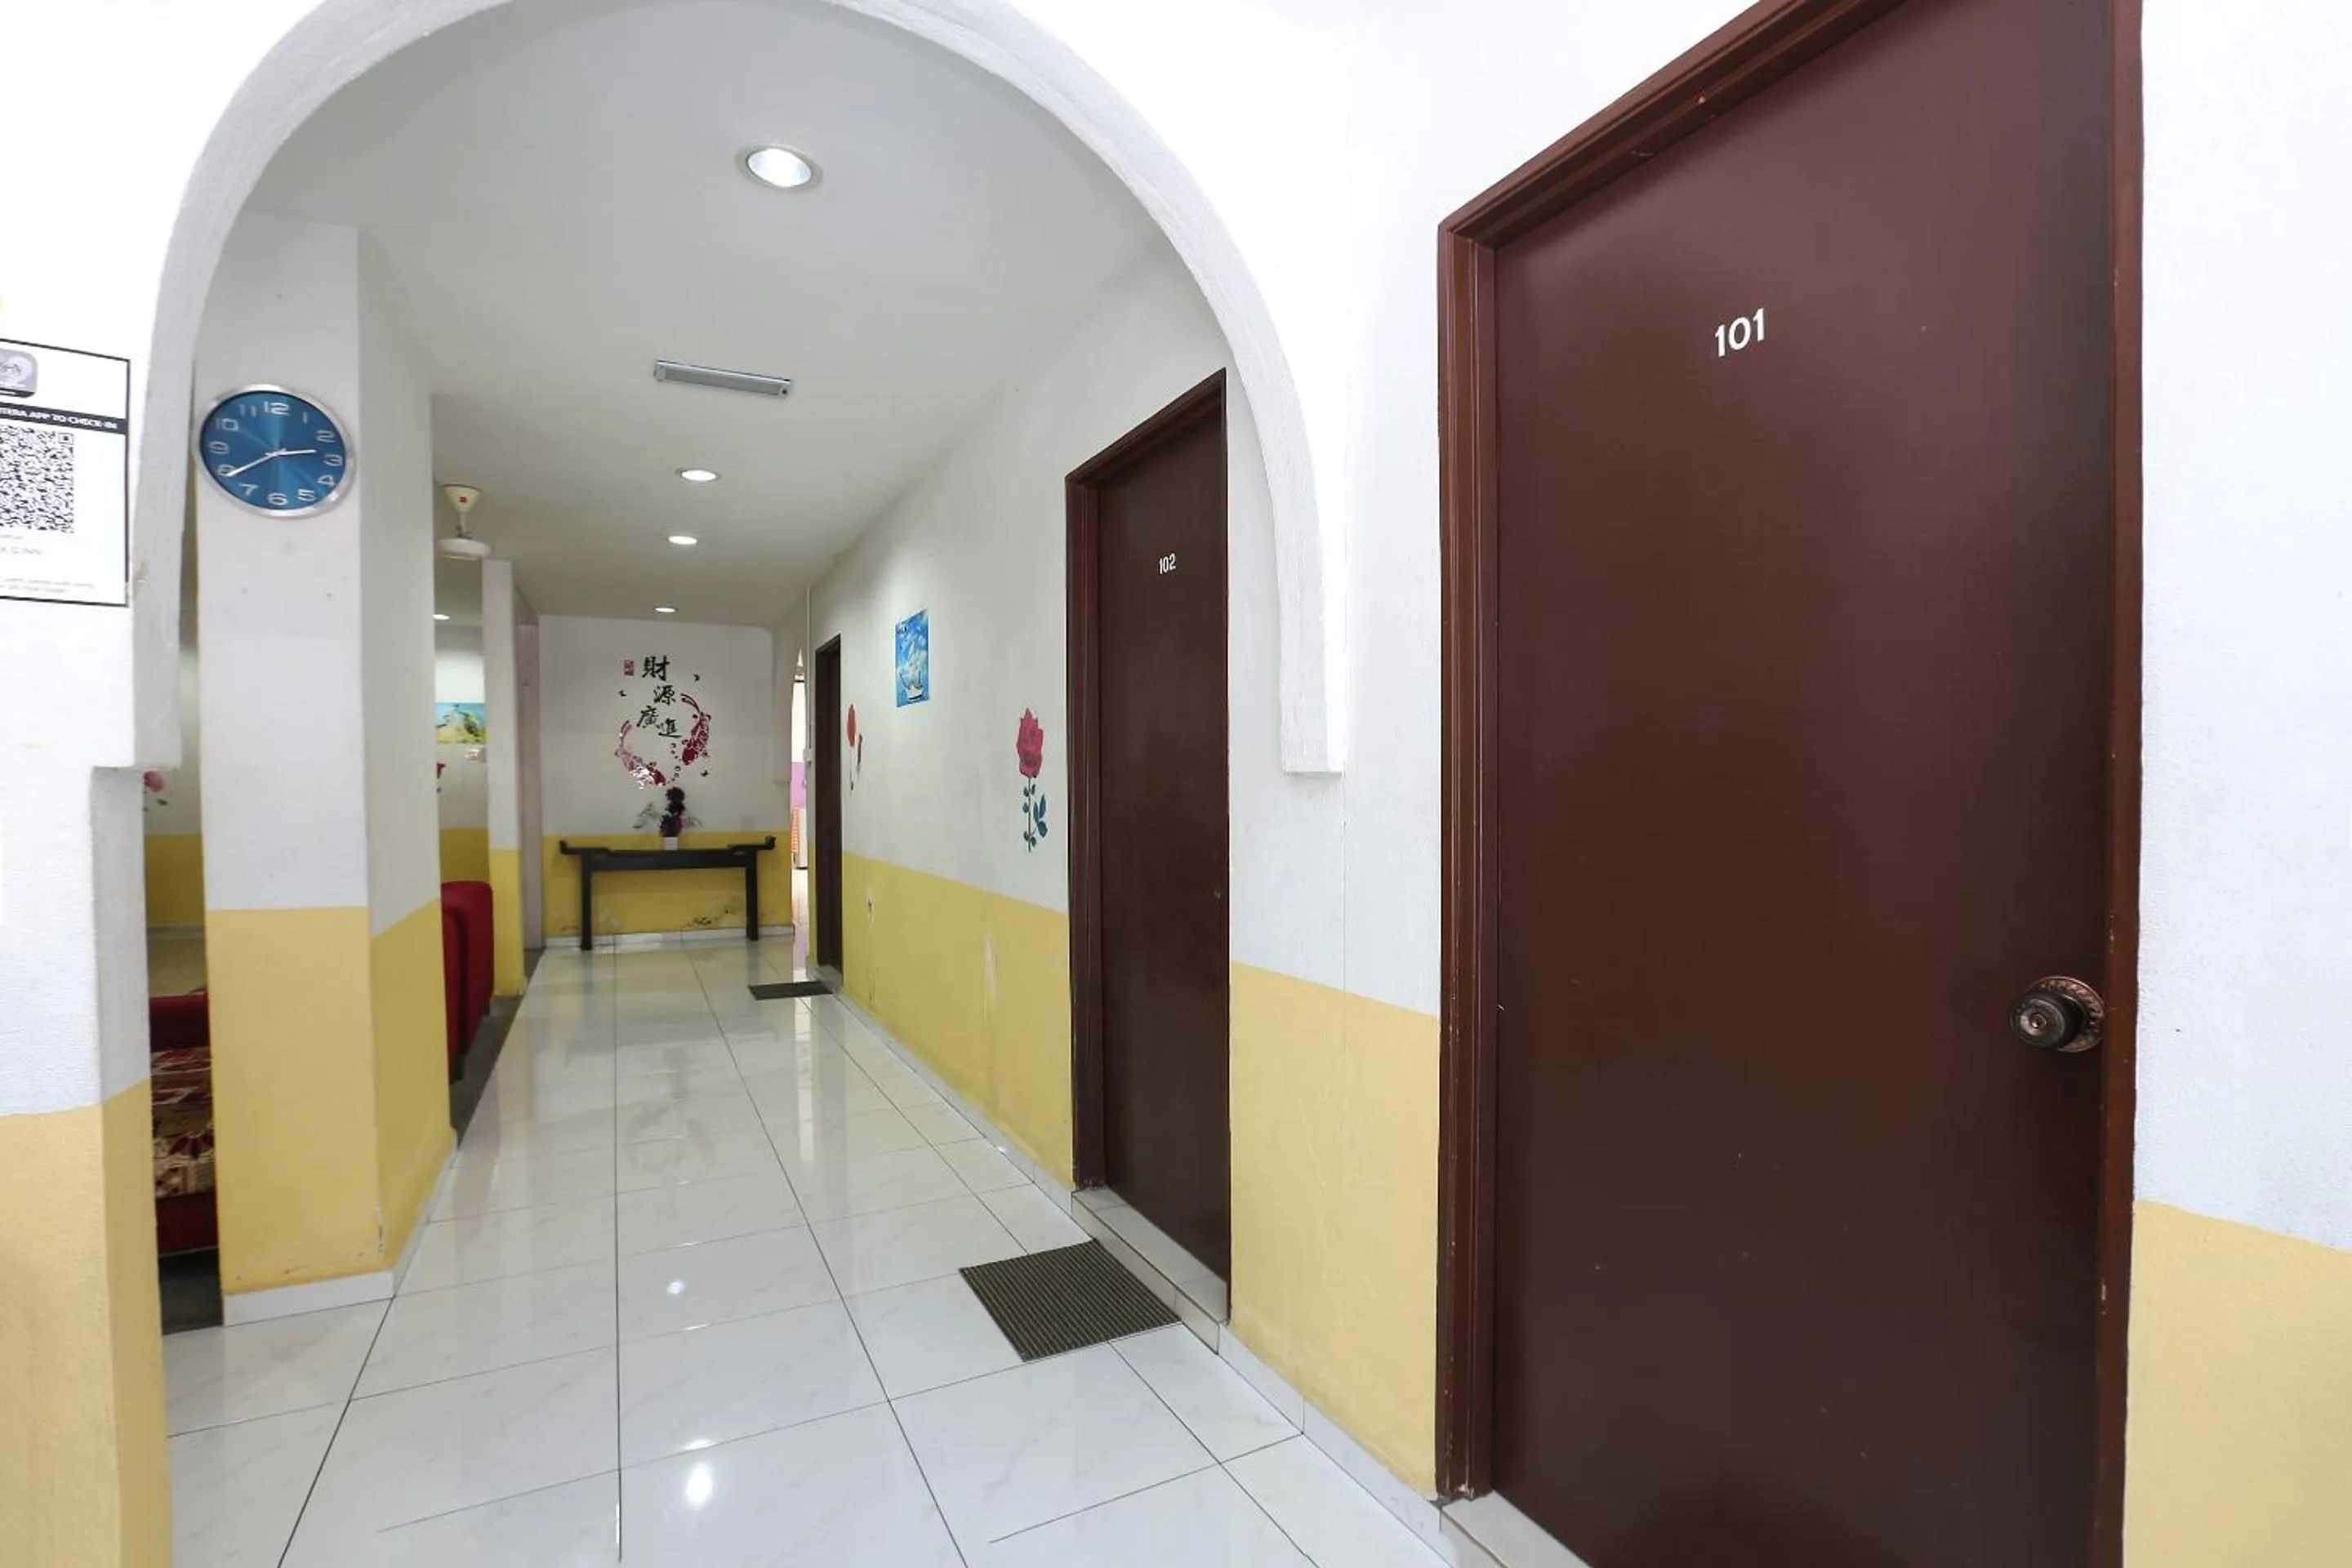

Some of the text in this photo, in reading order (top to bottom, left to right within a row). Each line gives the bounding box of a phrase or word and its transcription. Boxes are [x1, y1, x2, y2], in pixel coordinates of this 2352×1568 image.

[1715, 307, 1765, 358] 101
[239, 403, 257, 417] 11
[264, 401, 290, 415] 12
[29, 412, 51, 420] APP
[51, 413, 67, 423] TO
[68, 416, 118, 430] CHECK-IN
[302, 412, 308, 424] 1
[216, 418, 239, 432] 10
[316, 430, 336, 443] 2
[209, 441, 229, 454] 9
[323, 454, 343, 466] 3
[217, 464, 236, 477] 8
[317, 474, 336, 487] 4
[238, 483, 258, 496] 7
[297, 489, 316, 501] 5
[268, 492, 289, 506] 6
[1159, 553, 1176, 575] 102
